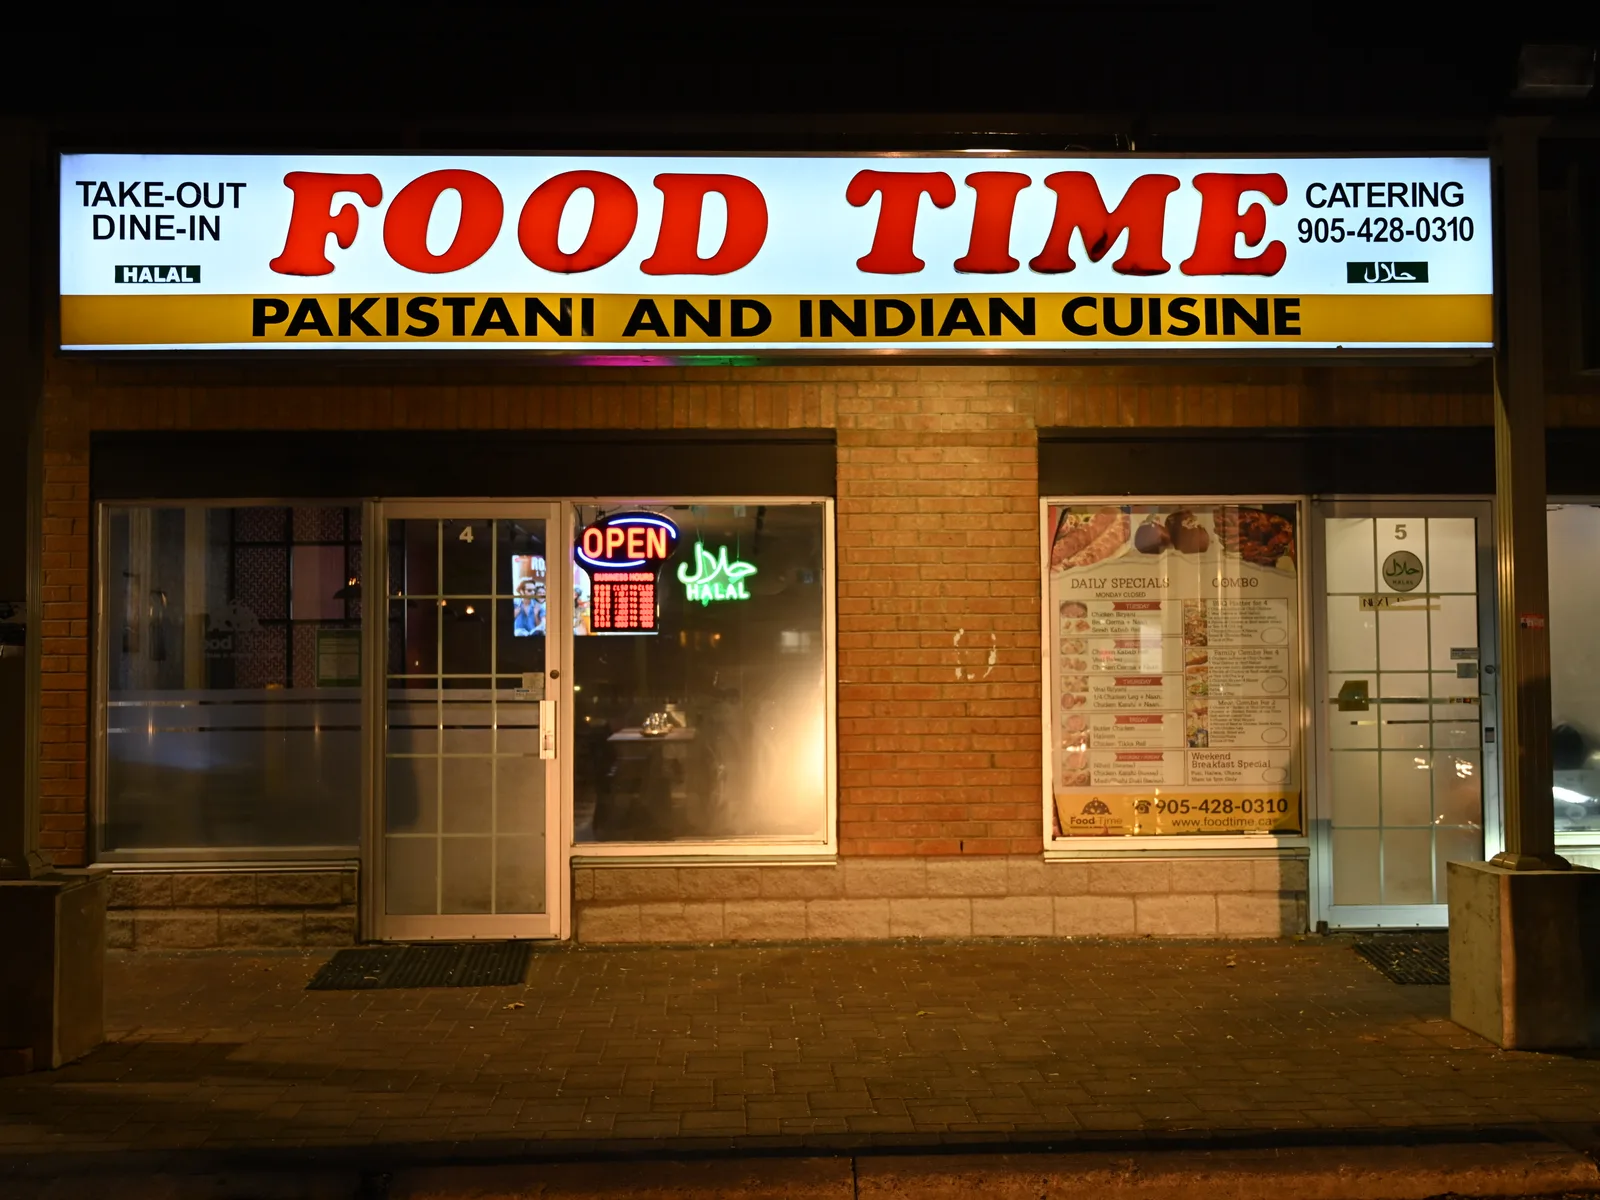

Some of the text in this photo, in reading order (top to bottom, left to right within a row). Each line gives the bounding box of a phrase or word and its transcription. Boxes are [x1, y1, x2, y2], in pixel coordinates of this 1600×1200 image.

[76, 181, 246, 209] TAKE-OUT
[1306, 181, 1464, 209] CATERING
[92, 214, 220, 241] DINE-IN
[269, 168, 1288, 277] FOOD TIME
[1298, 216, 1474, 243] 905-428-0310
[123, 266, 193, 283] HALAL
[1363, 262, 1417, 283] حلال
[252, 297, 1301, 338] PAKISTANI AND INDIAN CUISINE
[459, 526, 474, 543] 4
[1395, 524, 1407, 540] 5
[583, 527, 666, 559] OPEN
[677, 541, 757, 585] حلال
[1386, 558, 1420, 577] حلال
[629, 573, 654, 581] HOURS
[1071, 577, 1170, 589] DAILY SPECIALS
[1212, 577, 1259, 588] COMBO
[686, 582, 751, 601] HALAL
[1192, 752, 1231, 760] Weekend
[1192, 760, 1271, 769] Breakfast Special
[1156, 798, 1288, 814] 905-428-0310
[1070, 816, 1123, 826] Food Time
[1172, 816, 1273, 828] www.foodtime.ca
